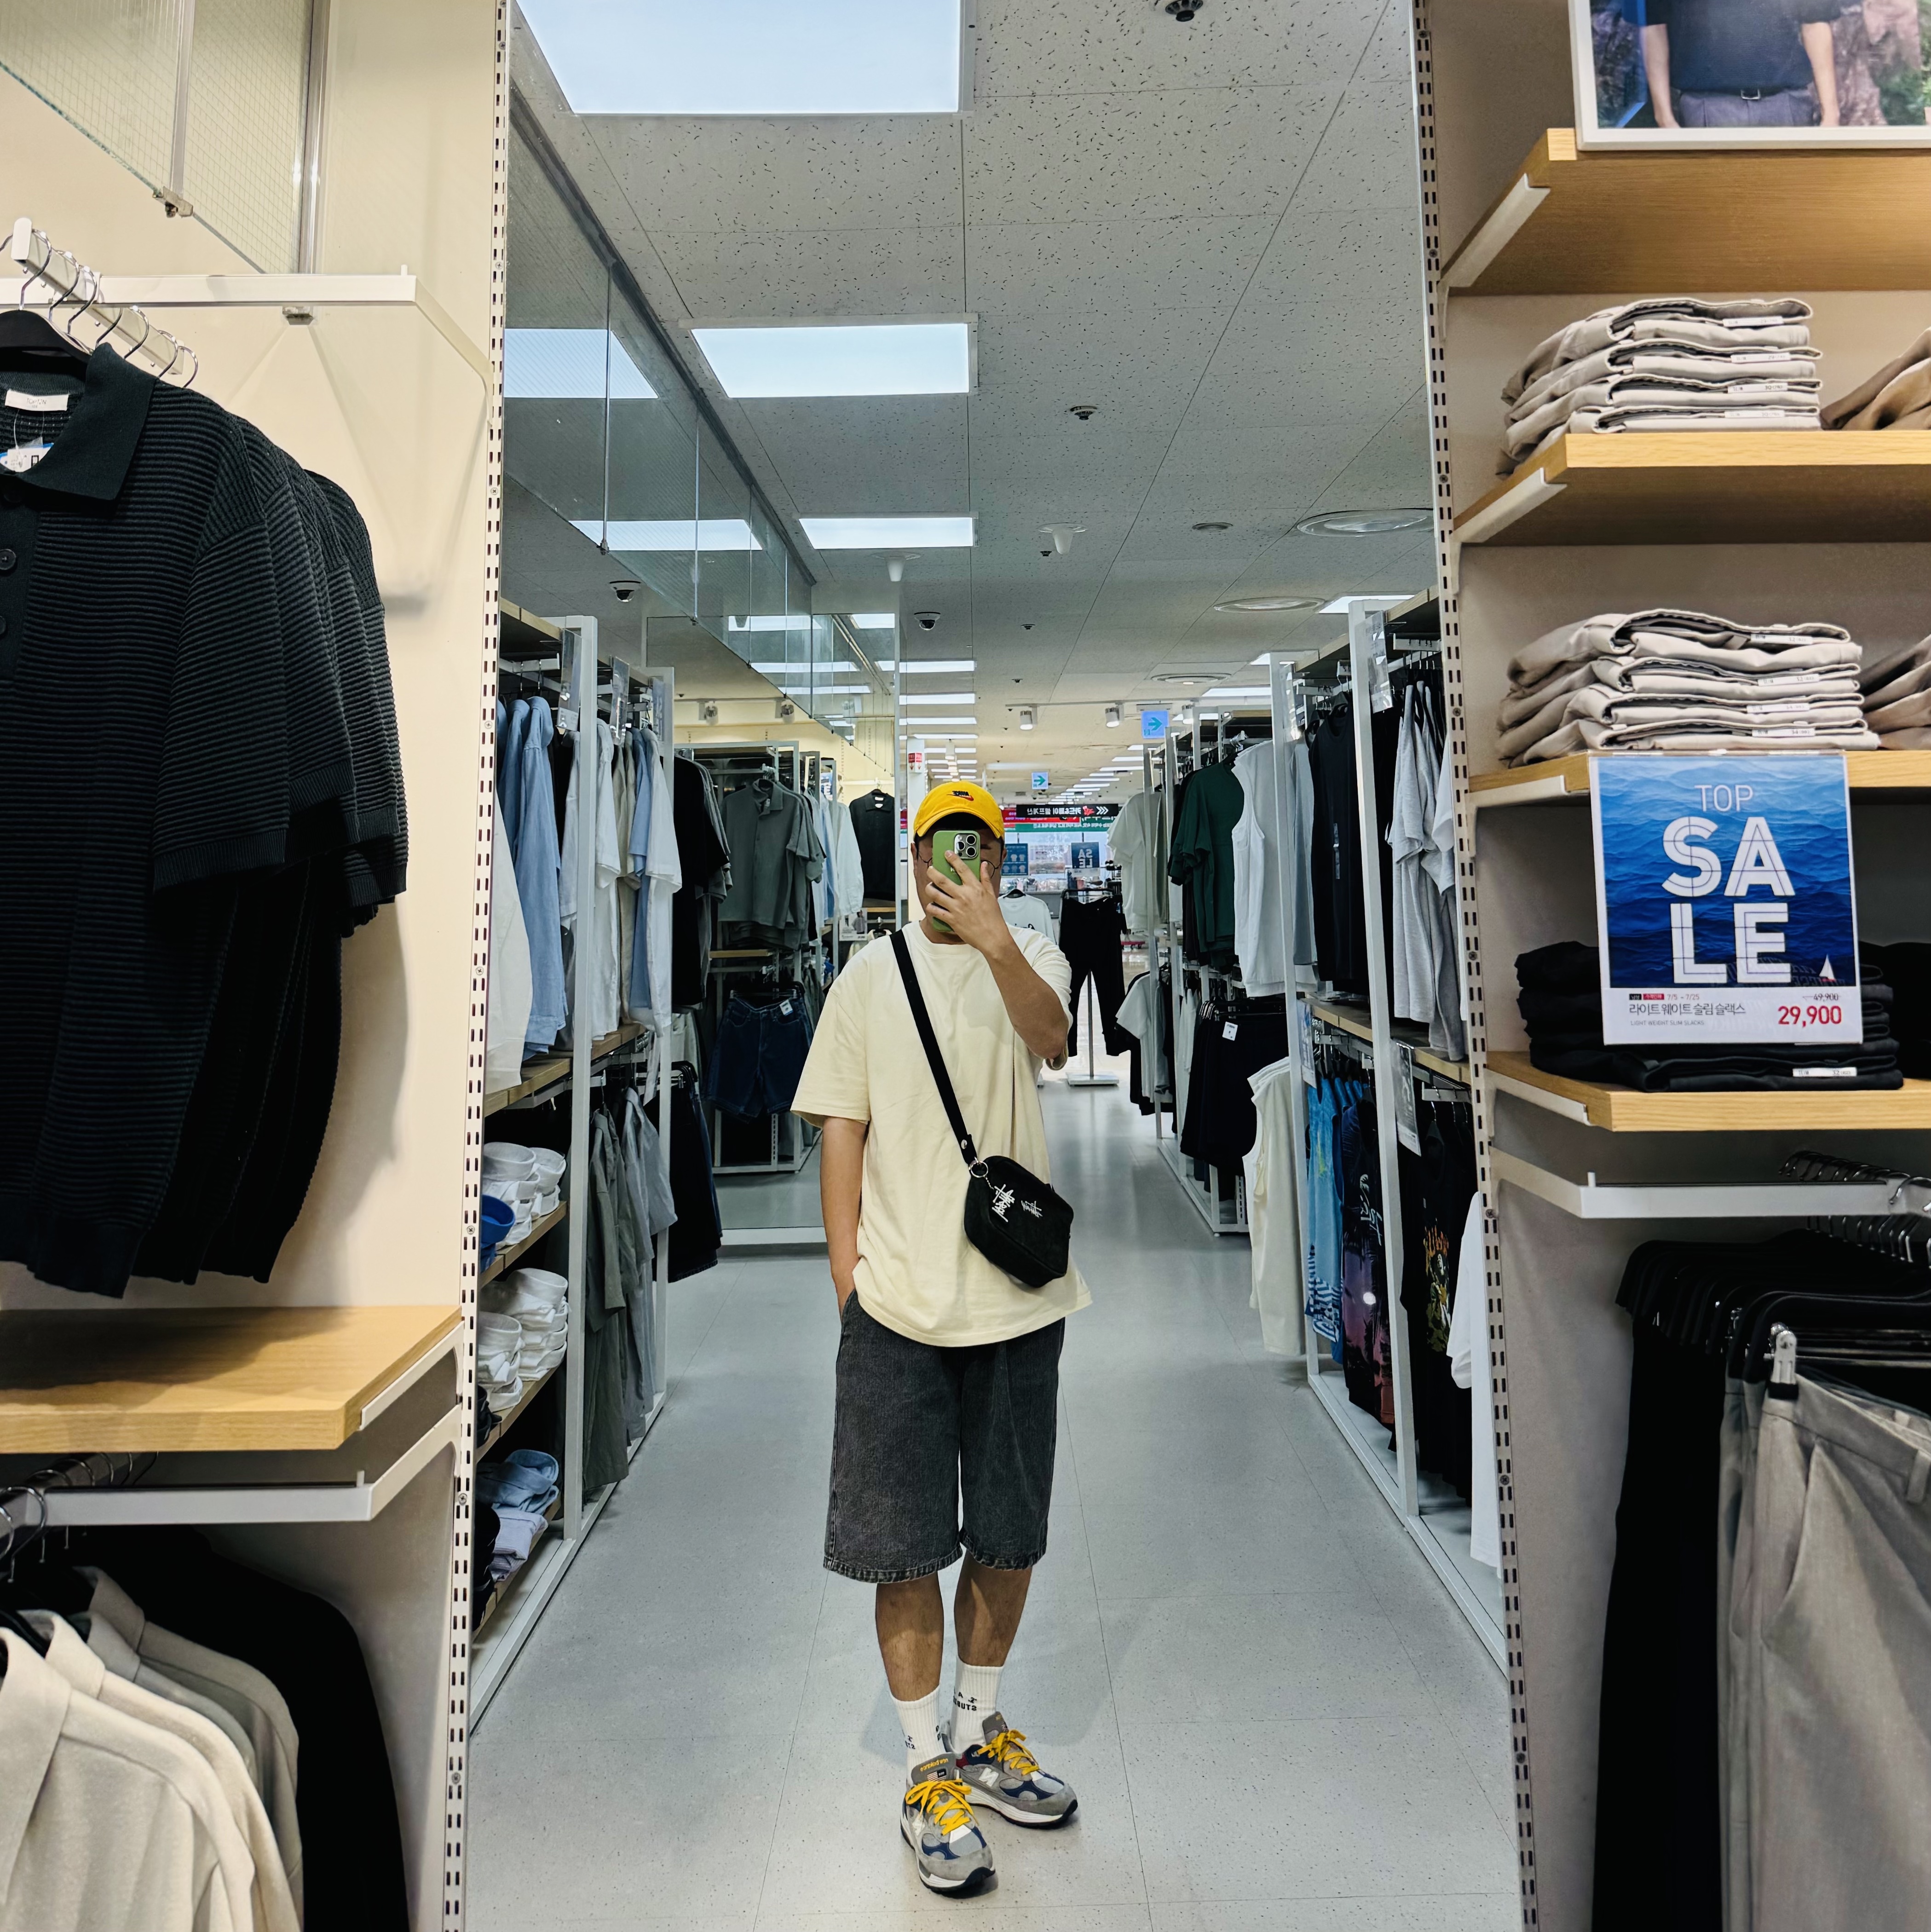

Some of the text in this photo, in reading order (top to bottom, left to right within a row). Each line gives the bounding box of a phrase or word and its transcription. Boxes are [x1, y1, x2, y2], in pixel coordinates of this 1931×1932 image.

[1694, 784, 1753, 812] TOP
[1814, 993, 1839, 1002] 49,900
[1693, 1003, 1713, 1015] 슬림
[1715, 1003, 1746, 1015] 슬랙스
[1778, 1005, 1842, 1028] 29,900
